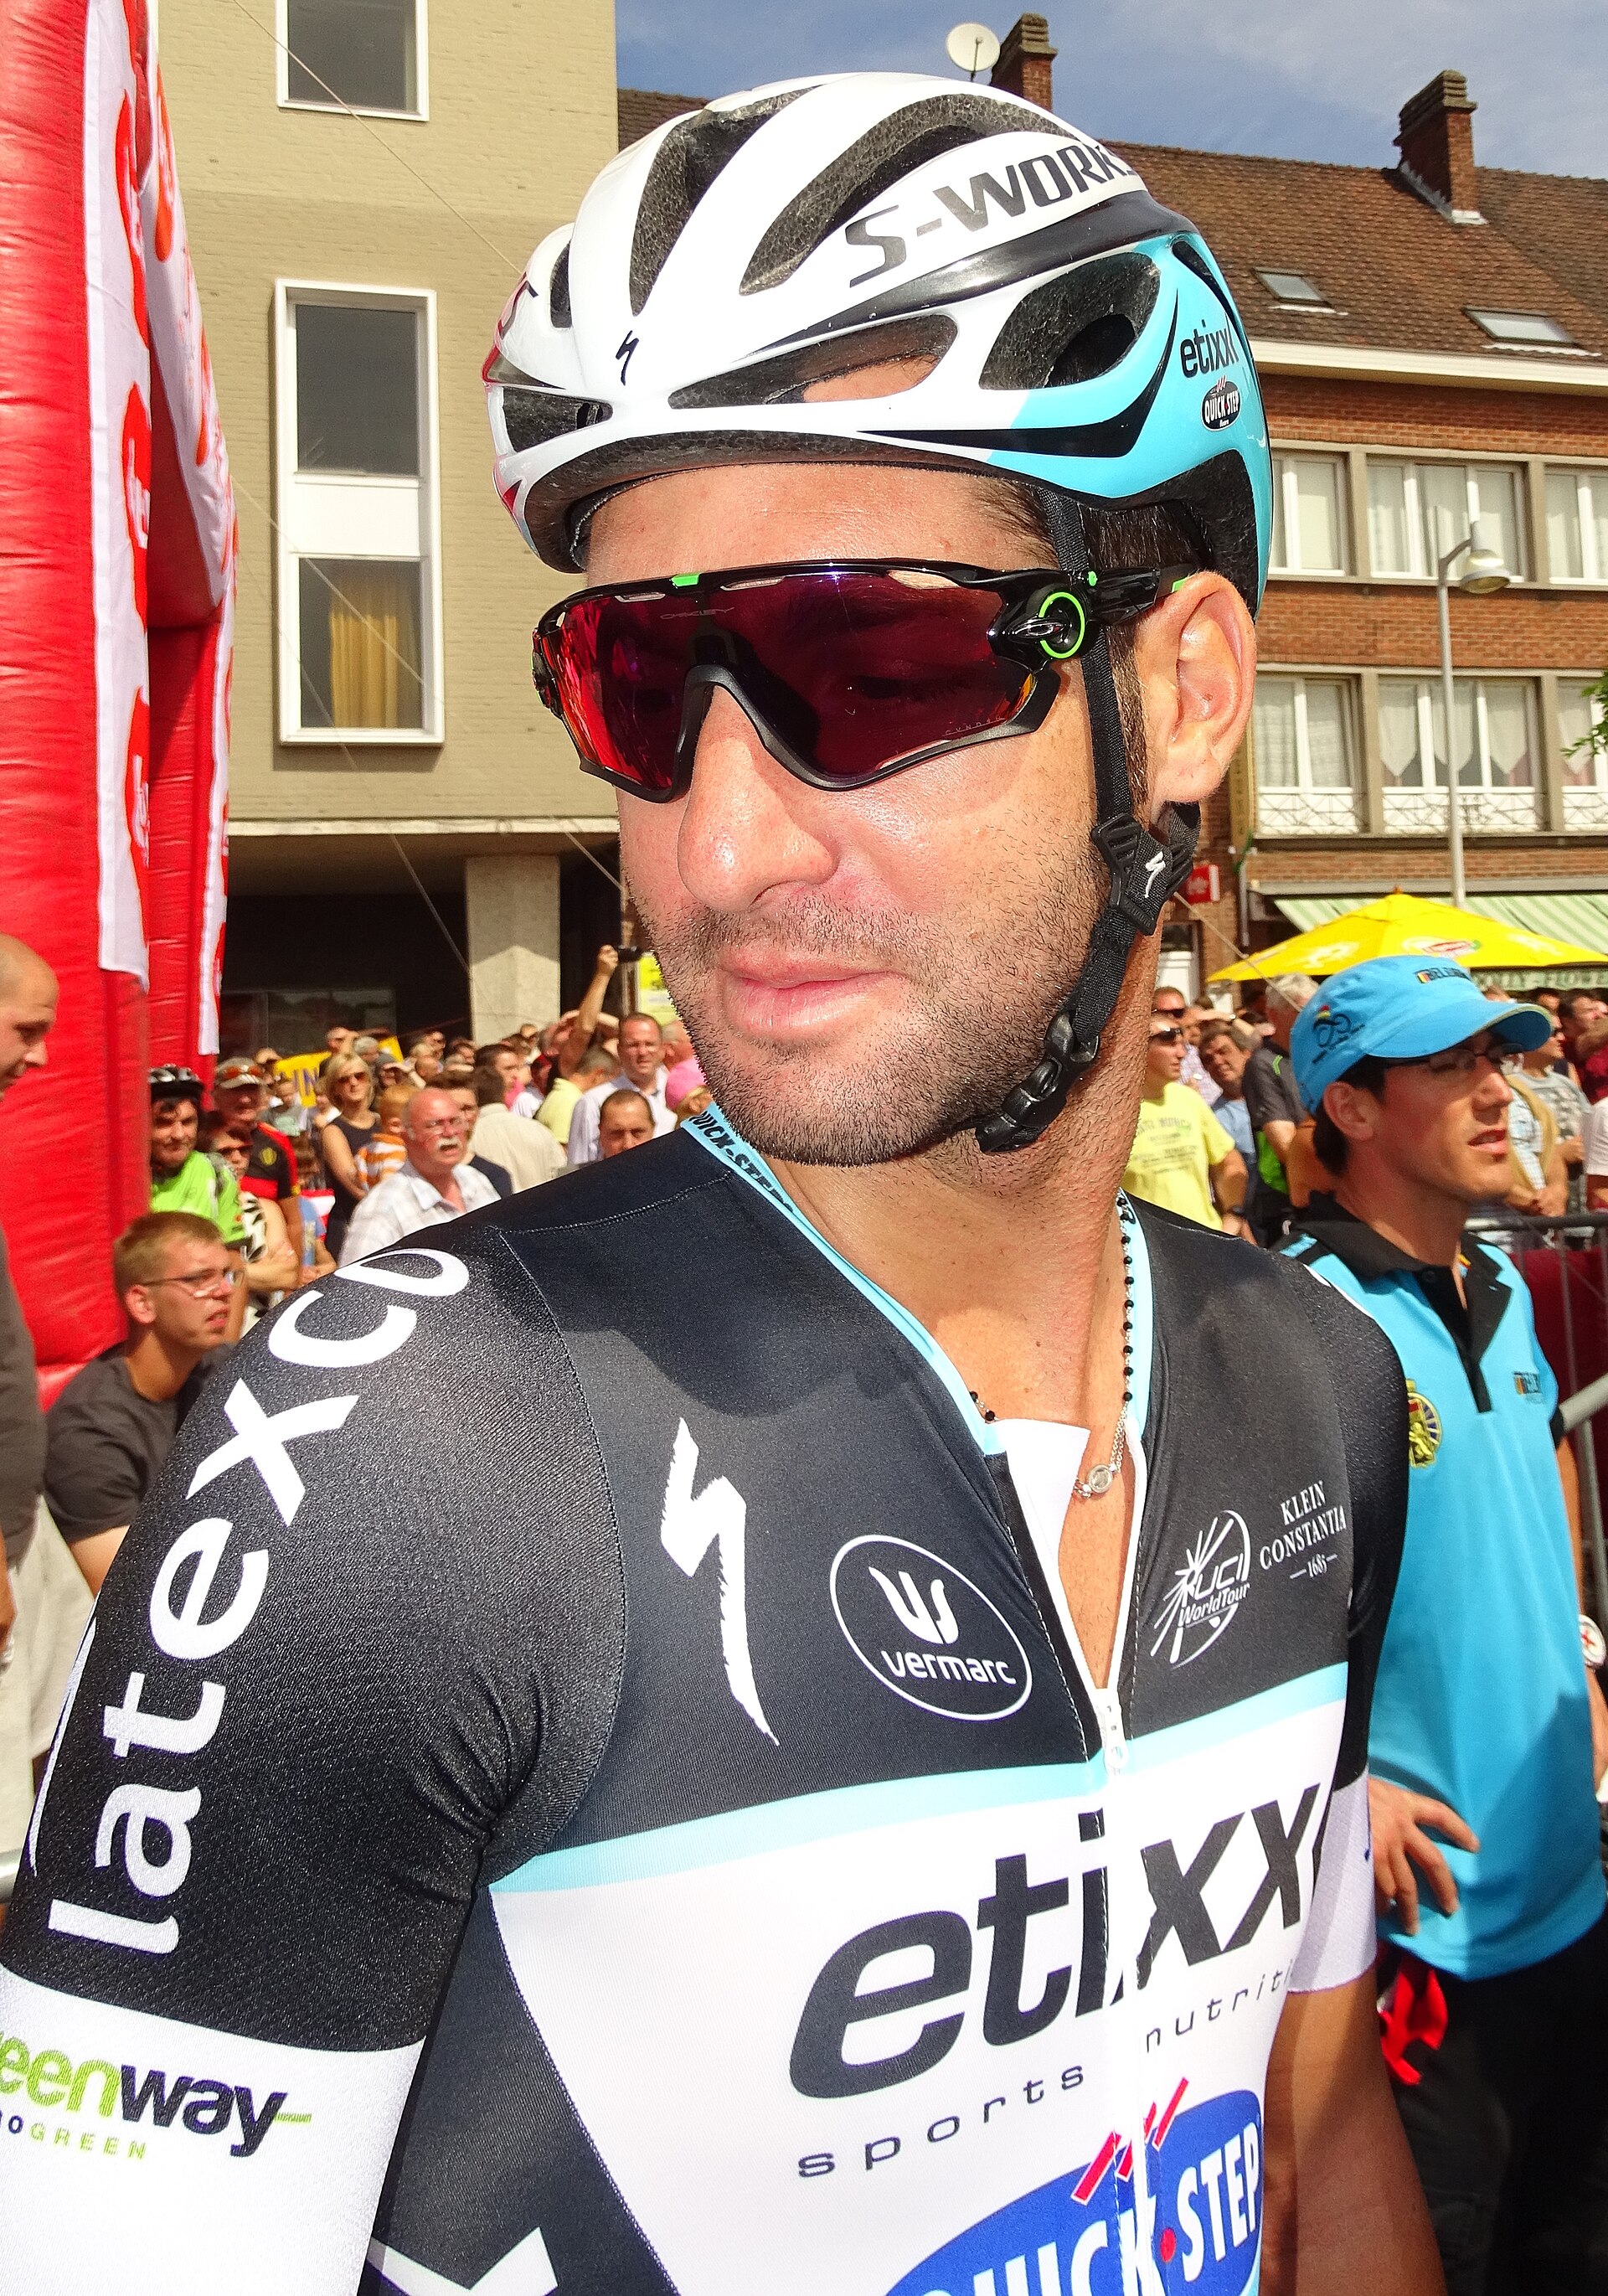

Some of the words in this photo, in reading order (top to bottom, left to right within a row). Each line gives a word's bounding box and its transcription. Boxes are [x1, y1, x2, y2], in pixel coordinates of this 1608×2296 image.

[845, 143, 1137, 287] S-WORK
[1260, 1505, 1347, 1571] CONSTANTIA
[1281, 1480, 1327, 1526] KLEIN
[48, 1246, 469, 1955] latexco
[1194, 1553, 1244, 1601] UCI
[881, 1650, 1017, 1685] vermarc
[789, 1783, 1321, 2099] etixx
[0, 2030, 289, 2159] eenway
[798, 2064, 1084, 2180] sports
